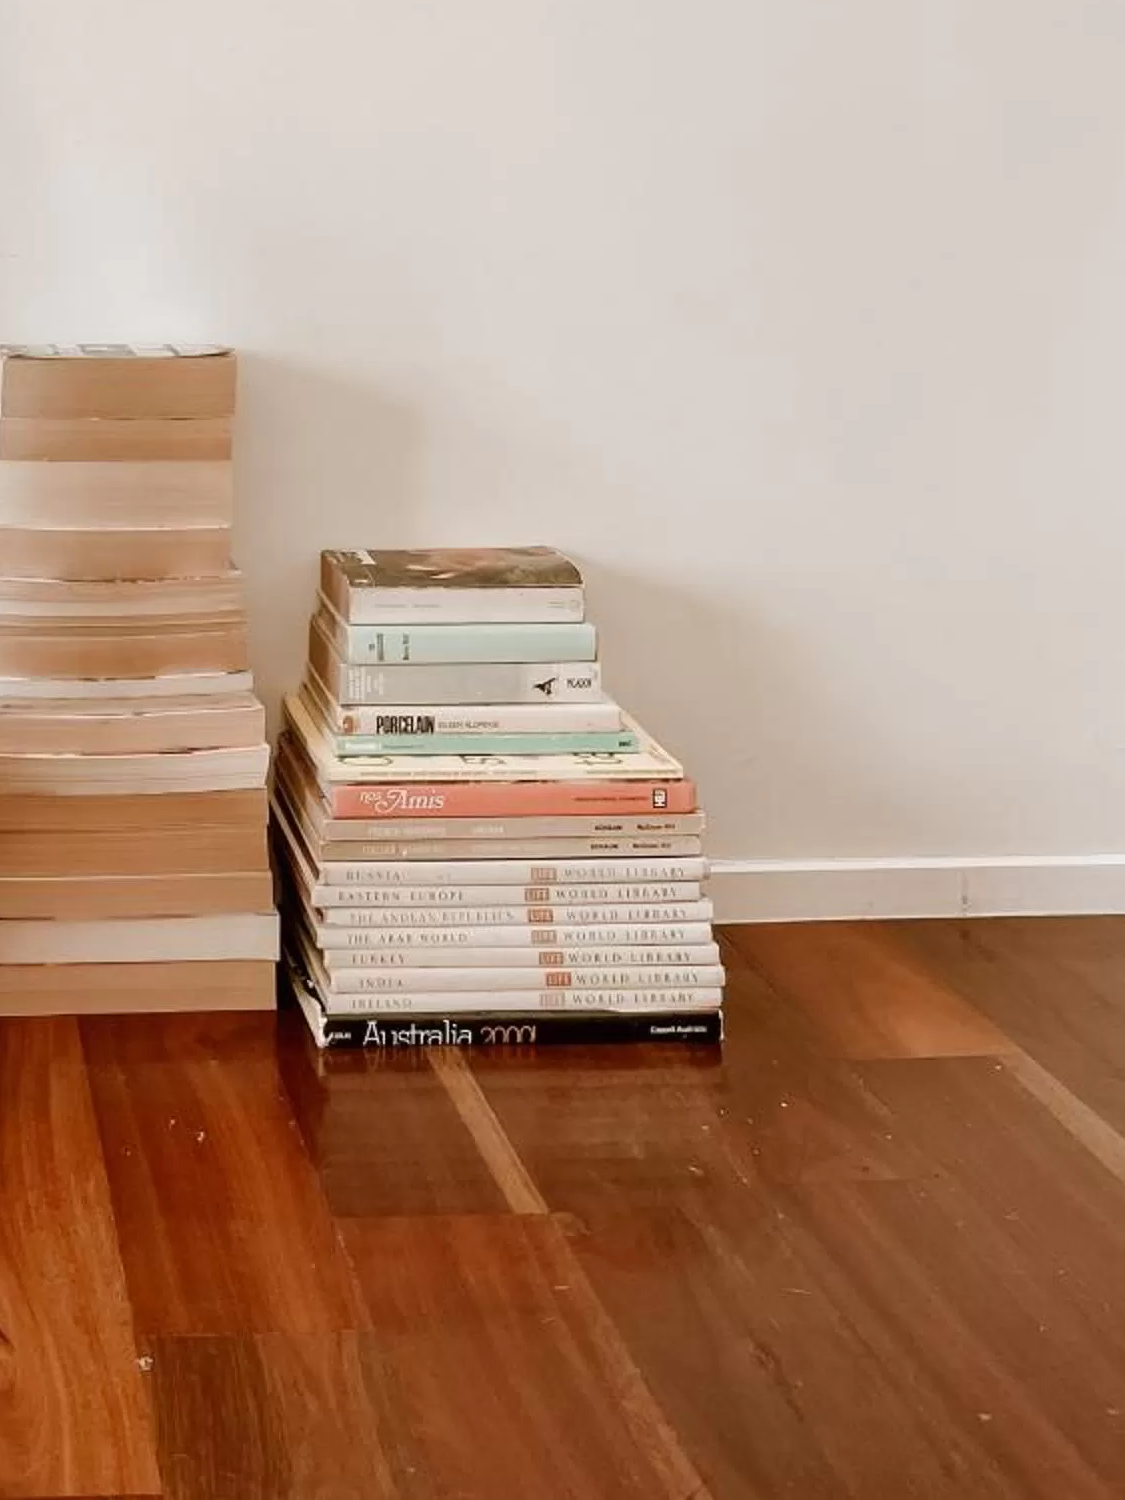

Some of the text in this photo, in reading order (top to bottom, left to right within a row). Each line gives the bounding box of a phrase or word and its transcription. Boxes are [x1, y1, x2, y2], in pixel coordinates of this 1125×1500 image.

[376, 715, 435, 734] PORCELAIN
[375, 788, 445, 813] Amis
[564, 868, 616, 879] WORLD
[626, 866, 685, 877] LIBRARY
[338, 889, 463, 901] EASTERN EUROPE
[556, 888, 608, 899] WORLD
[618, 887, 677, 899] LIBRARY
[350, 913, 373, 925] THE
[566, 909, 619, 921] WORLD
[628, 908, 687, 920] LIBRARY
[347, 932, 468, 945] THE ARAB WORLD
[564, 930, 616, 942] WORLD
[626, 929, 685, 941] LIBRARY
[352, 953, 405, 965] TURKEY
[568, 952, 622, 964] WORLD
[631, 950, 691, 963] LIBRARY
[359, 978, 404, 989] INDIA
[576, 973, 629, 985] WORLD
[638, 971, 699, 984] LIBRARY
[351, 999, 413, 1010] IRELAND
[572, 993, 625, 1005] WORLD
[634, 992, 694, 1004] LIBRARY
[363, 1019, 473, 1045] Australia
